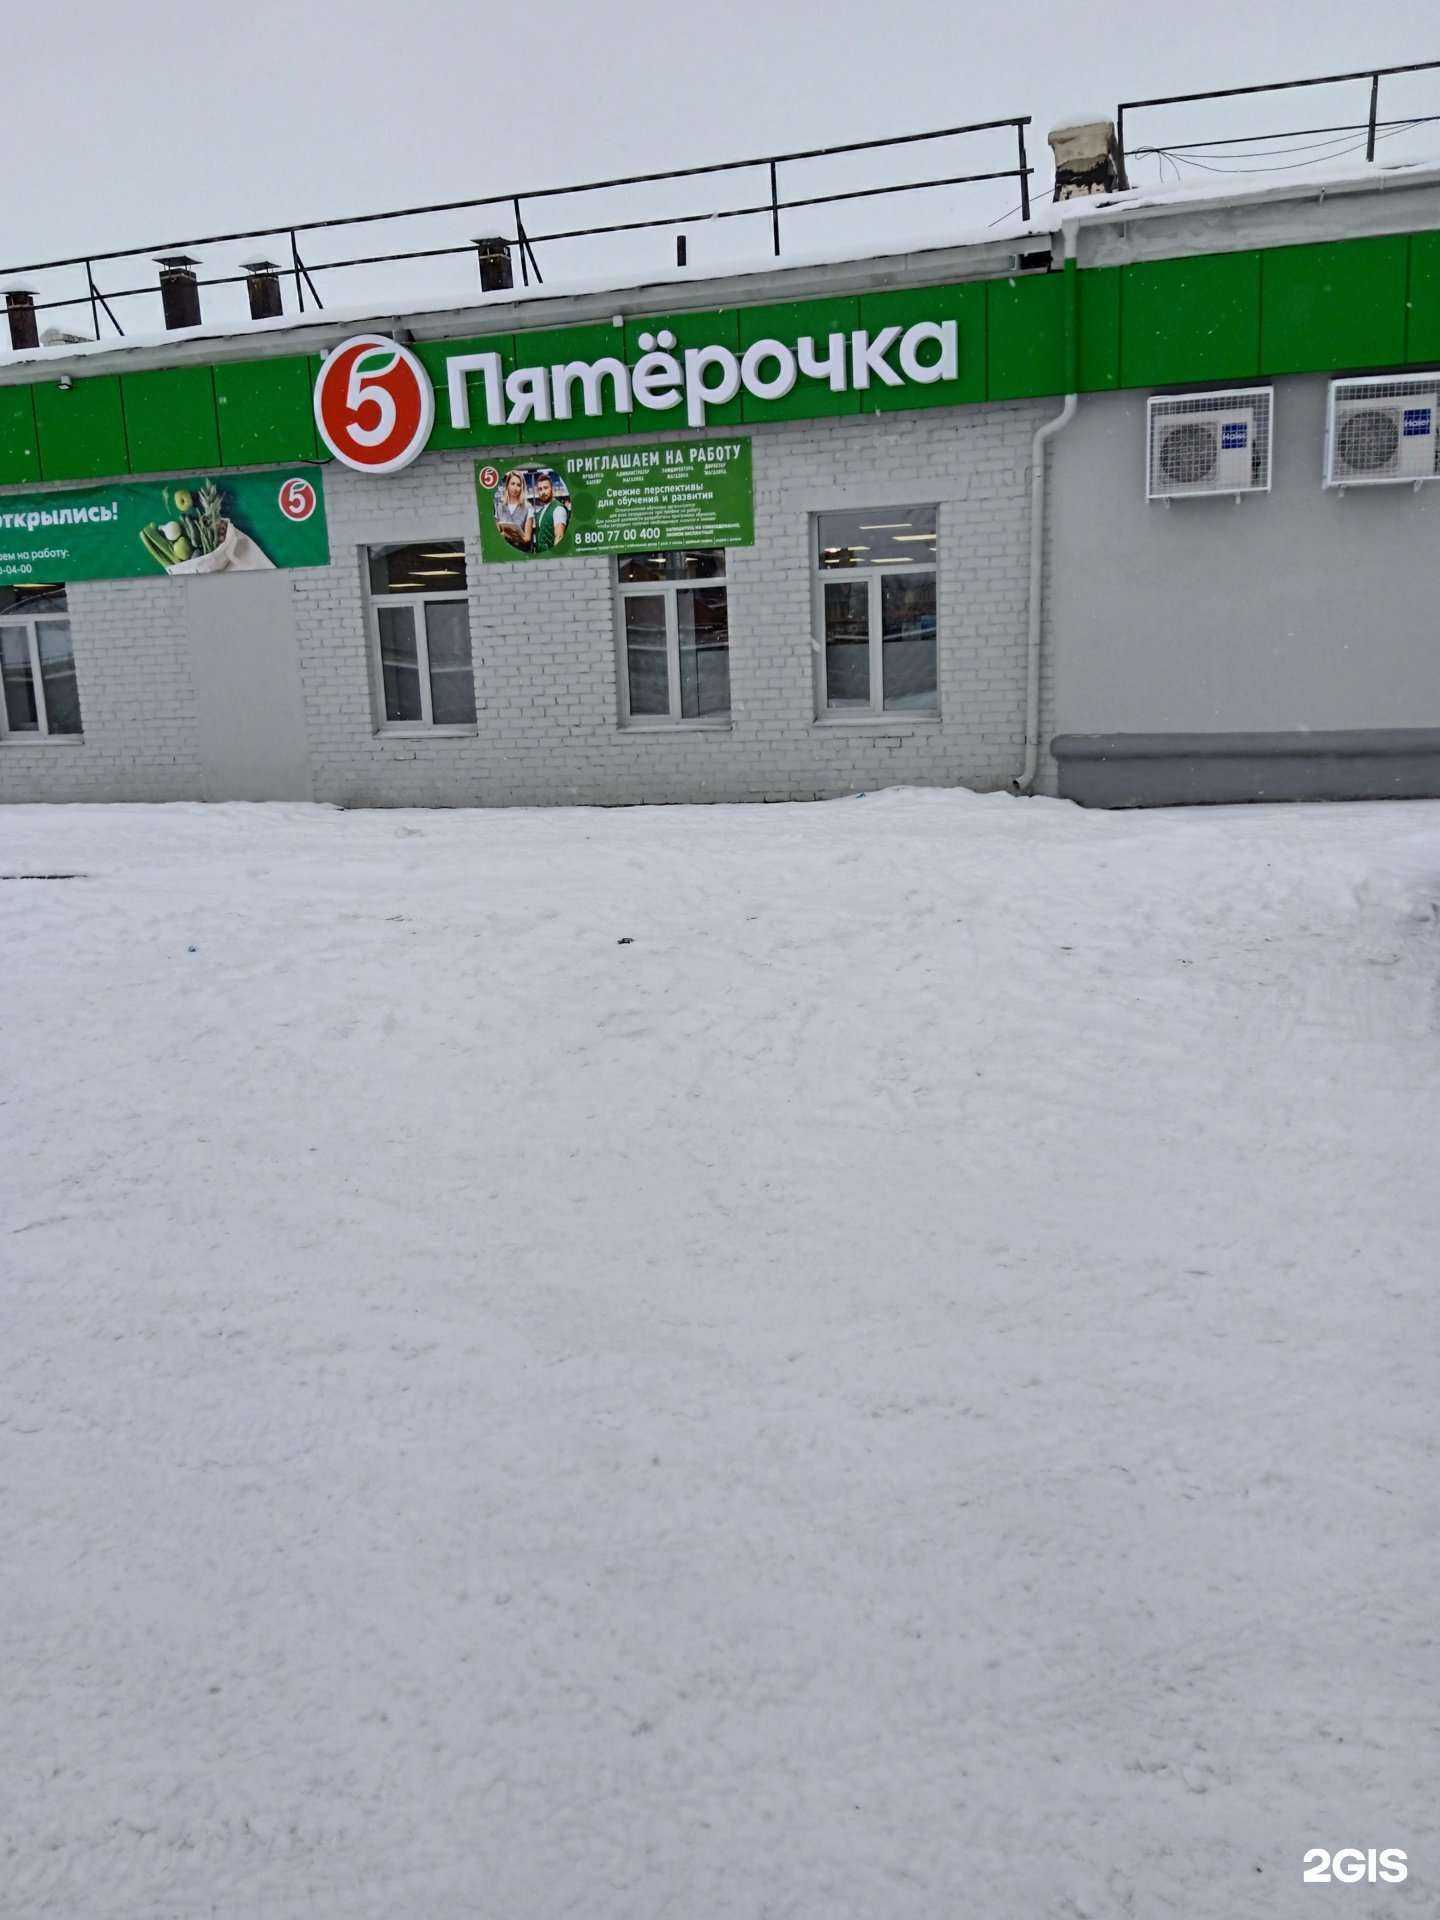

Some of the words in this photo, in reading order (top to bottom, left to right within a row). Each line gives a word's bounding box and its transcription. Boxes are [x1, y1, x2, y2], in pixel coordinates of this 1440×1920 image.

[445, 319, 960, 428] Пятёрочка
[346, 350, 400, 447] 5
[567, 451, 659, 473] ПРИГЛАШАЕМ
[665, 448, 684, 465] НА
[689, 444, 741, 463] РАБОТУ
[287, 482, 308, 514] 5
[598, 498, 614, 508] для
[617, 494, 659, 506] обучения
[662, 494, 669, 502] и
[671, 491, 714, 503] развития
[606, 487, 641, 498] Свежие
[644, 483, 704, 496] перспективы
[0, 501, 118, 531] ткрылись!
[574, 532, 582, 545] 8
[584, 530, 605, 543] 800
[607, 529, 620, 542] 77
[623, 528, 637, 541] 00
[639, 527, 660, 540] 400
[16, 551, 30, 560] на
